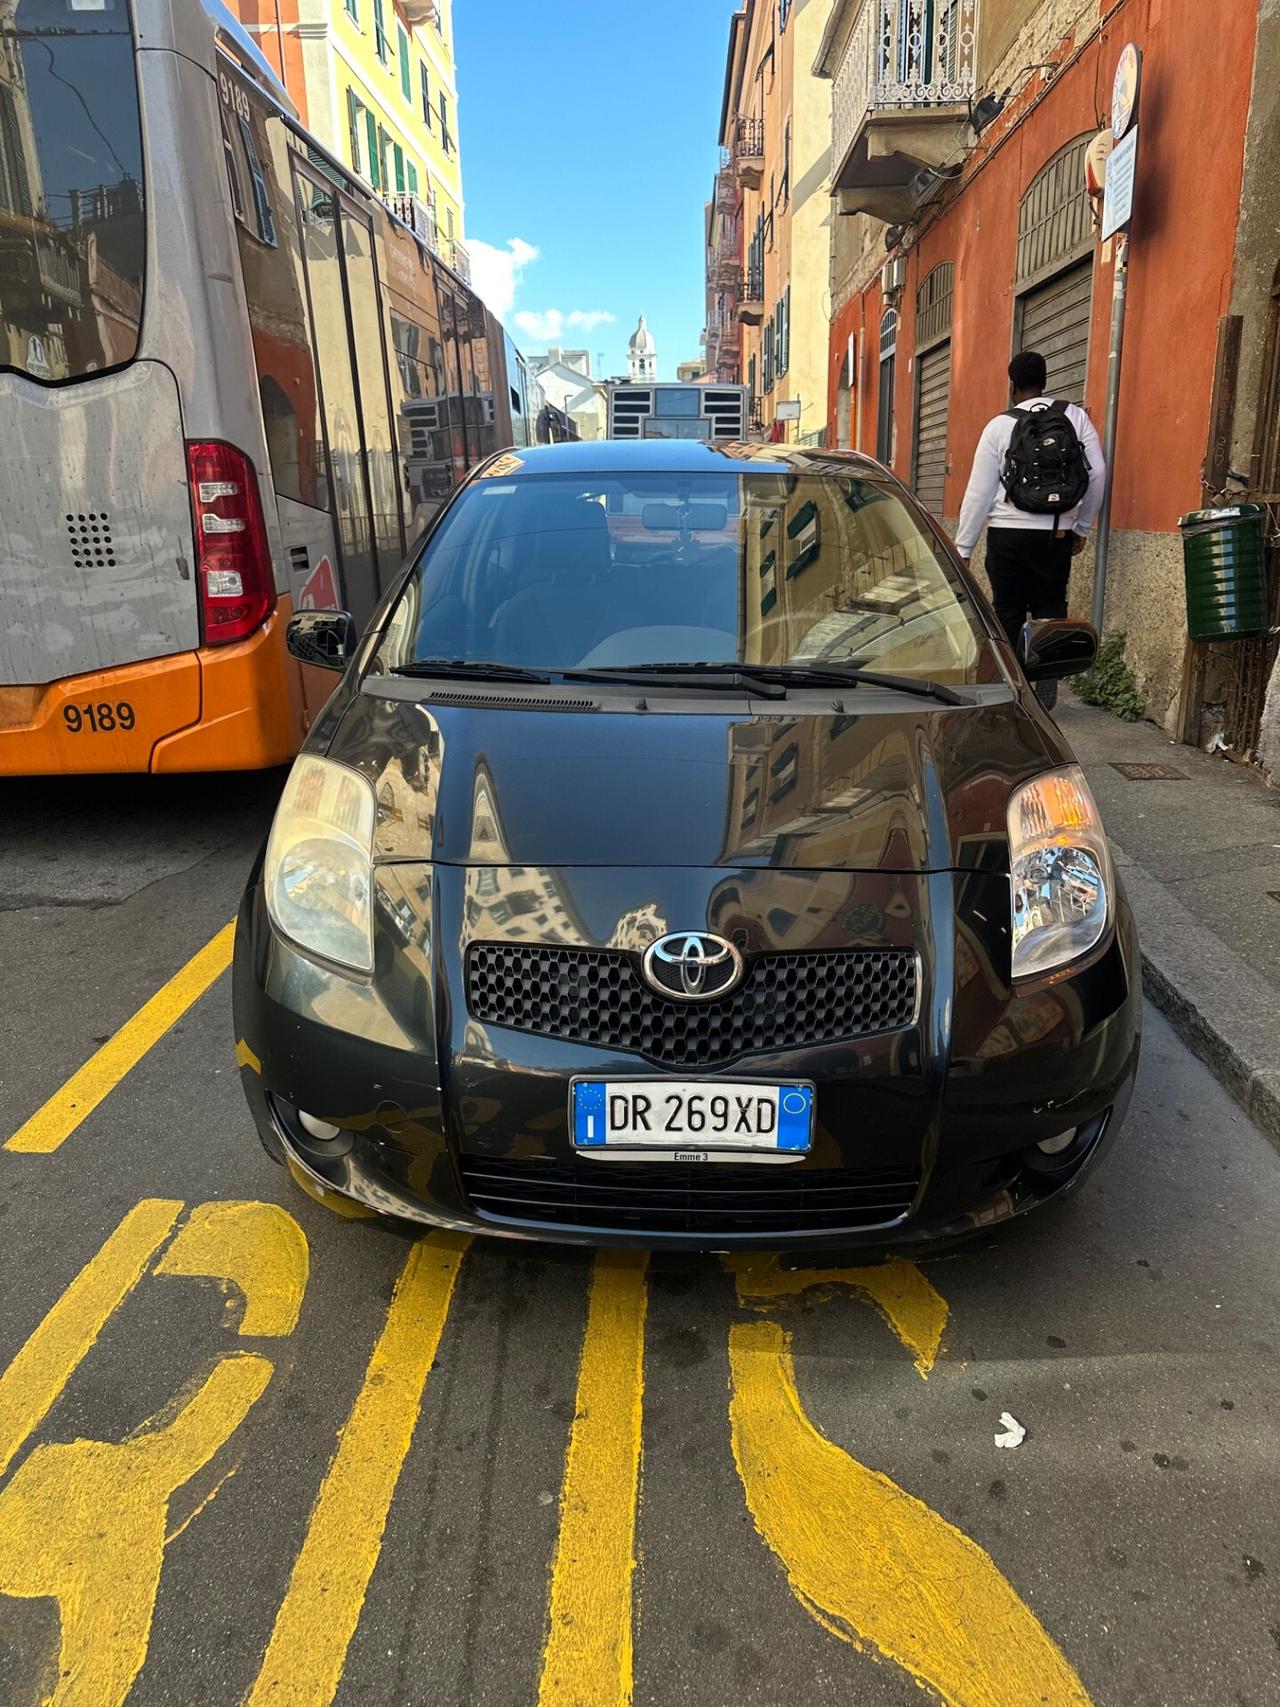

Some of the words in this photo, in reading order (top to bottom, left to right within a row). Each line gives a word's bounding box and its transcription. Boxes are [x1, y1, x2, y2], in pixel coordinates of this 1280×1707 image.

[221, 72, 250, 122] 9189
[63, 702, 135, 733] 9189
[610, 1095, 652, 1131] DR
[665, 1095, 776, 1133] 269XD
[673, 1152, 701, 1162] Emme
[702, 1152, 709, 1162] 3
